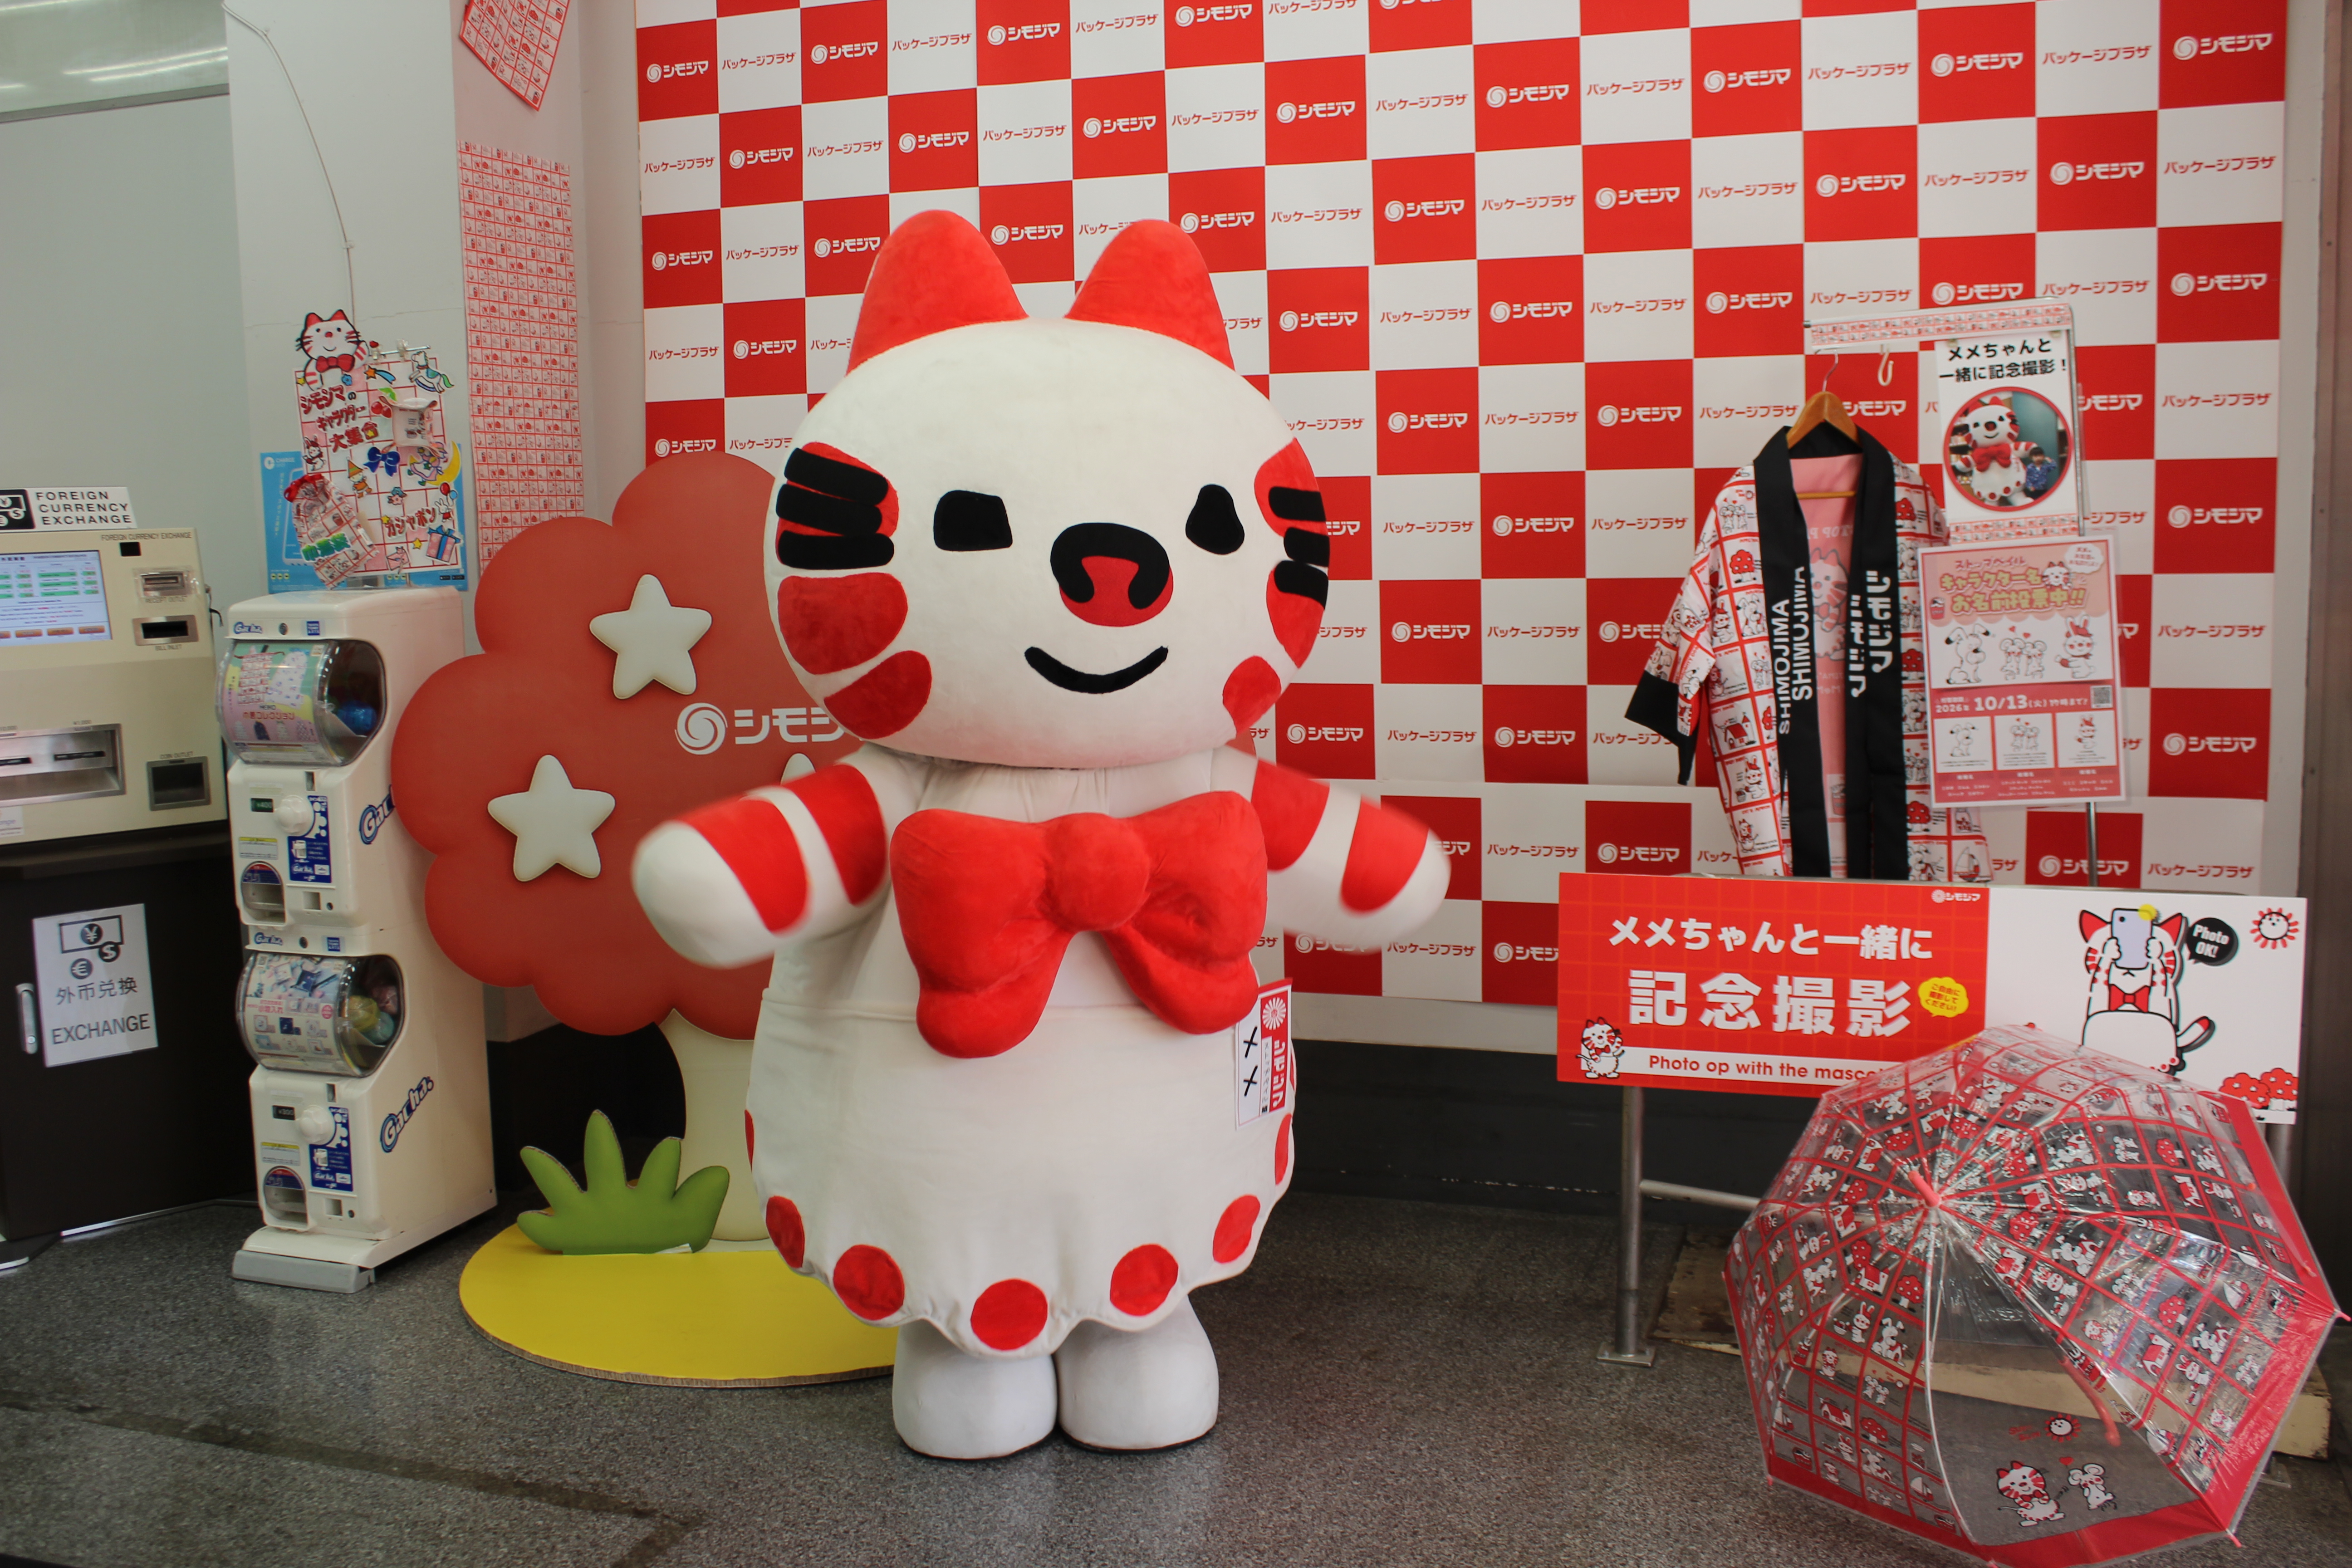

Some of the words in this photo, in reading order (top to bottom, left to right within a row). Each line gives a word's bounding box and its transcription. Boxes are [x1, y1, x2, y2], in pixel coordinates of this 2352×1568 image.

[1196, 4, 1252, 22] シモジマ
[1076, 14, 1157, 33] パッケージプラザ
[1008, 23, 1060, 41] シモジマ
[830, 41, 878, 59] シモジマ
[892, 34, 970, 51] パッケージプラザ
[2201, 34, 2272, 54] シモジマ
[722, 52, 795, 70] パッケージプラザ
[1957, 53, 2023, 72] シモジマ
[2043, 45, 2151, 64] パッケージプラザ
[664, 61, 709, 78] シモジマ
[1808, 63, 1909, 79] パッケージプラザ
[1587, 78, 1683, 95] パッケージプラザ
[1728, 69, 1791, 88] シモジマ
[1509, 84, 1569, 103] シモジマ
[1298, 101, 1356, 119] シモジマ
[1376, 94, 1466, 111] パッケージプラザ
[1103, 116, 1156, 133] シモジマ
[1172, 109, 1257, 126] パッケージプラザ
[918, 131, 969, 148] シモジマ
[983, 125, 1065, 141] パッケージプラザ
[747, 147, 794, 164] シモジマ
[807, 141, 882, 157] パッケージプラザ
[644, 157, 714, 173] パッケージプラザ
[2076, 162, 2144, 181] シモジマ
[2164, 156, 2276, 174] パッケージプラザ
[1841, 174, 1906, 192] シモジマ
[1925, 170, 2027, 186] パッケージプラザ
[1619, 187, 1680, 205] シモジマ
[1698, 182, 1796, 198] パッケージプラザ
[1406, 199, 1465, 217] シモジマ
[1482, 195, 1575, 211] パッケージプラザ
[1201, 211, 1255, 229] シモジマ
[1271, 208, 1361, 223] パッケージプラザ
[1011, 224, 1063, 241] シモジマ
[726, 245, 798, 260] パッケージプラザ
[833, 237, 881, 253] シモジマ
[669, 250, 713, 266] シモジマ
[2043, 280, 2148, 296] パッケージプラザ
[2198, 274, 2266, 291] シモジマ
[1810, 289, 1910, 304] パッケージプラザ
[1957, 283, 2023, 301] シモジマ
[1590, 299, 1685, 314] パッケージプラザ
[1730, 292, 1793, 309] シモジマ
[1380, 308, 1470, 323] パッケージプラザ
[1513, 302, 1573, 318] シモジマ
[1301, 311, 1358, 328] シモジマ
[648, 346, 719, 360] パッケージプラザ
[751, 340, 797, 355] シモジマ
[1948, 338, 2052, 361] メメちゃんと
[1939, 358, 2067, 382] 一緒に記念撮影!
[2162, 393, 2271, 408] パッケージプラザ
[1485, 412, 1577, 425] パッケージプラザ
[1621, 406, 1681, 422] シモジマ
[1700, 405, 1797, 419] パッケージプラザ
[1286, 417, 1363, 431] ッケージプラザ
[1410, 413, 1468, 429] シモジマ
[672, 439, 716, 453] シモジマ
[35, 491, 110, 500] FOREIGN
[39, 503, 129, 513] CURRENCY
[2195, 508, 2262, 524] シモジマ
[41, 514, 132, 525] EXCHANGE
[1515, 517, 1574, 533] シモジマ
[1592, 517, 1687, 530] パッケージプラザ
[2083, 511, 2148, 523] ージプラザ
[1326, 521, 1360, 535] ジマ
[1383, 521, 1474, 534] パッケージプラザ
[1940, 566, 2042, 592] キャラクター名
[1865, 570, 1893, 673] シモジマ
[1413, 625, 1470, 639] シモジマ
[1487, 626, 1580, 638] パッケージプラザ
[2158, 625, 2265, 638] パッケージプラザ
[1771, 599, 1792, 735] SHIMOJIMA
[734, 707, 847, 745] シモジ
[1308, 727, 1363, 741] シモジマ
[1387, 730, 1476, 743] パッケージプラザ
[1518, 730, 1575, 745] シモジマ
[2189, 737, 2256, 752] シモジマ
[1487, 844, 1579, 858] パッケージプラザ
[1621, 847, 1679, 862] シモジマ
[2147, 863, 2254, 879] パッケージプラザ
[1946, 892, 1980, 903] シモジマ
[1609, 916, 1933, 960] メメちゃんと一緒に
[2192, 924, 2230, 945] Photo
[1387, 942, 1476, 957] パッケージプラザ
[1515, 947, 1558, 963] シモジ
[2195, 941, 2219, 958] OK!
[56, 976, 137, 1006] 外币兑换
[1628, 969, 1911, 1038] 記念撮影
[52, 1013, 151, 1045] EXCHANGE
[1243, 1026, 1258, 1097] メメ
[1650, 1055, 1700, 1072] Photo
[1706, 1059, 1729, 1075] op
[1736, 1061, 1773, 1076] with
[1779, 1063, 1808, 1078] the
[1272, 1039, 1286, 1108] シモジマ
